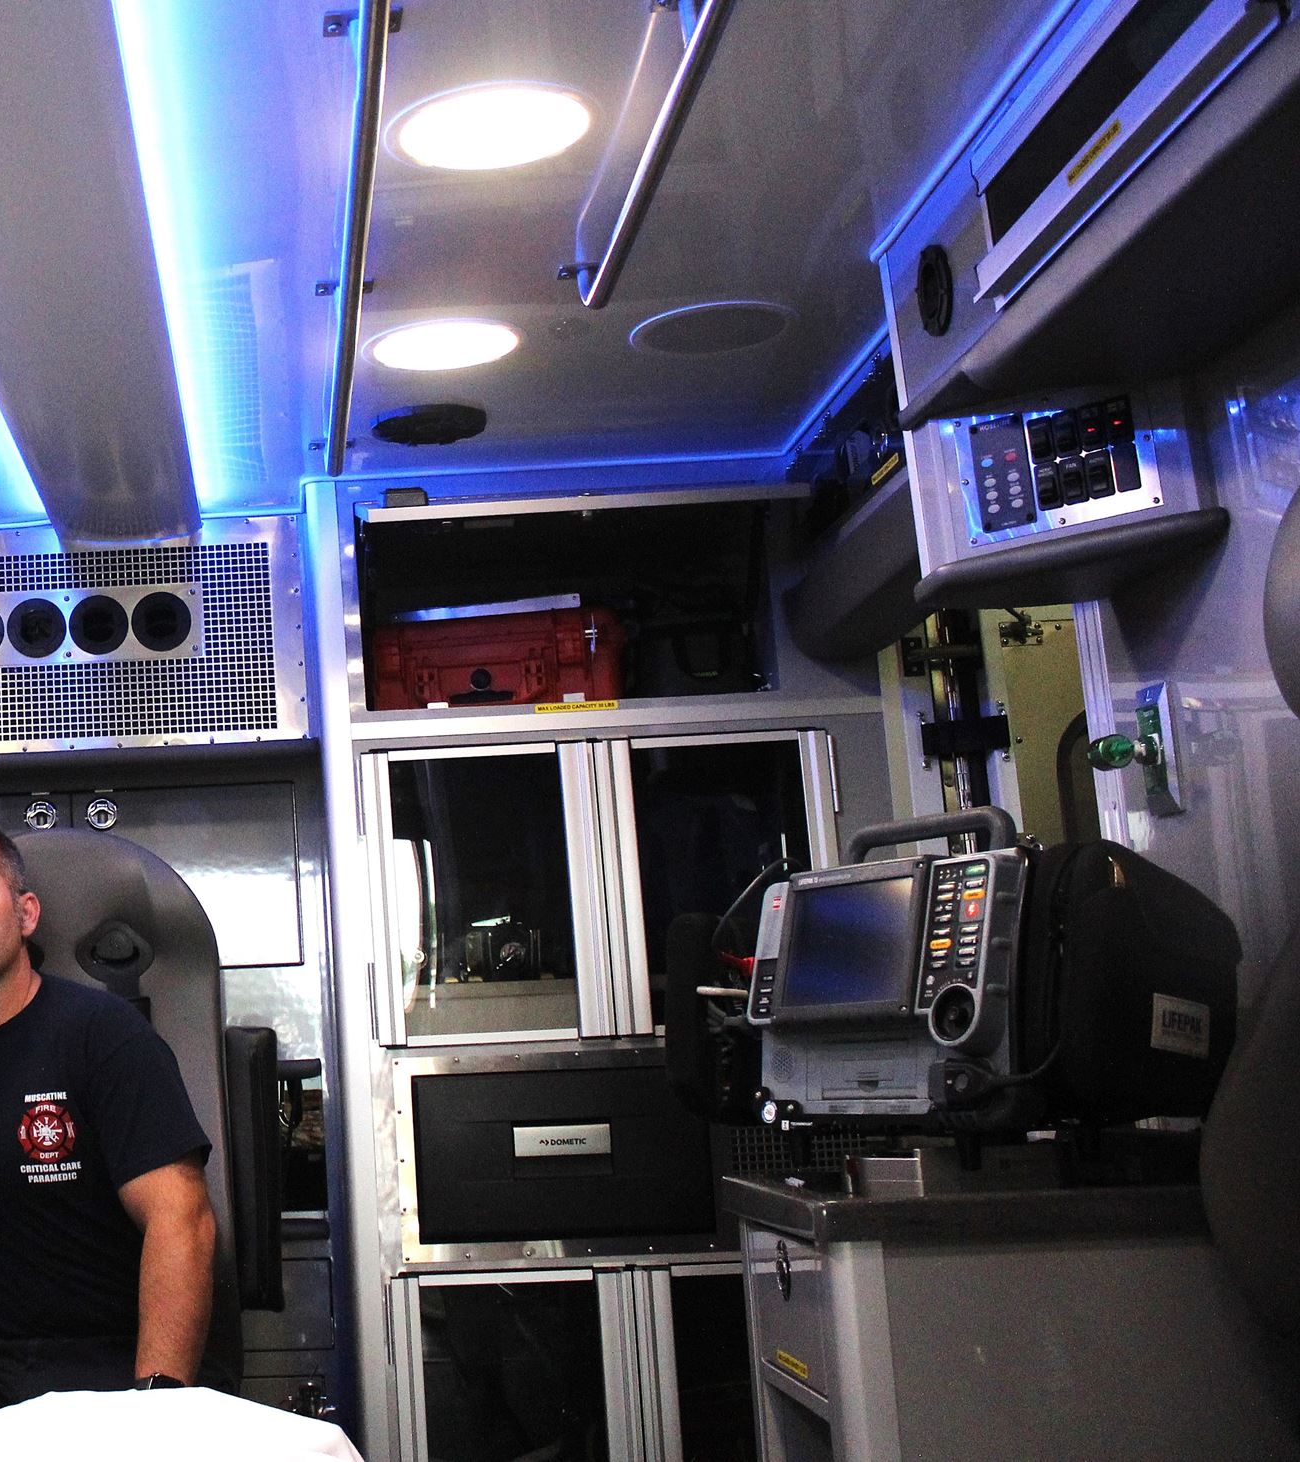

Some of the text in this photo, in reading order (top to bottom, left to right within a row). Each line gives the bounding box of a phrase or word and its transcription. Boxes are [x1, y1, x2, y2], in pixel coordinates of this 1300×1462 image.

[24, 1091, 67, 1103] MUSCATINE
[35, 1104, 57, 1114] FIRE
[550, 1137, 587, 1146] DOMETIC
[39, 1151, 59, 1159] DEPT
[20, 1161, 82, 1173] CRITICAL CARE
[28, 1172, 77, 1183] PARAMEDIC
